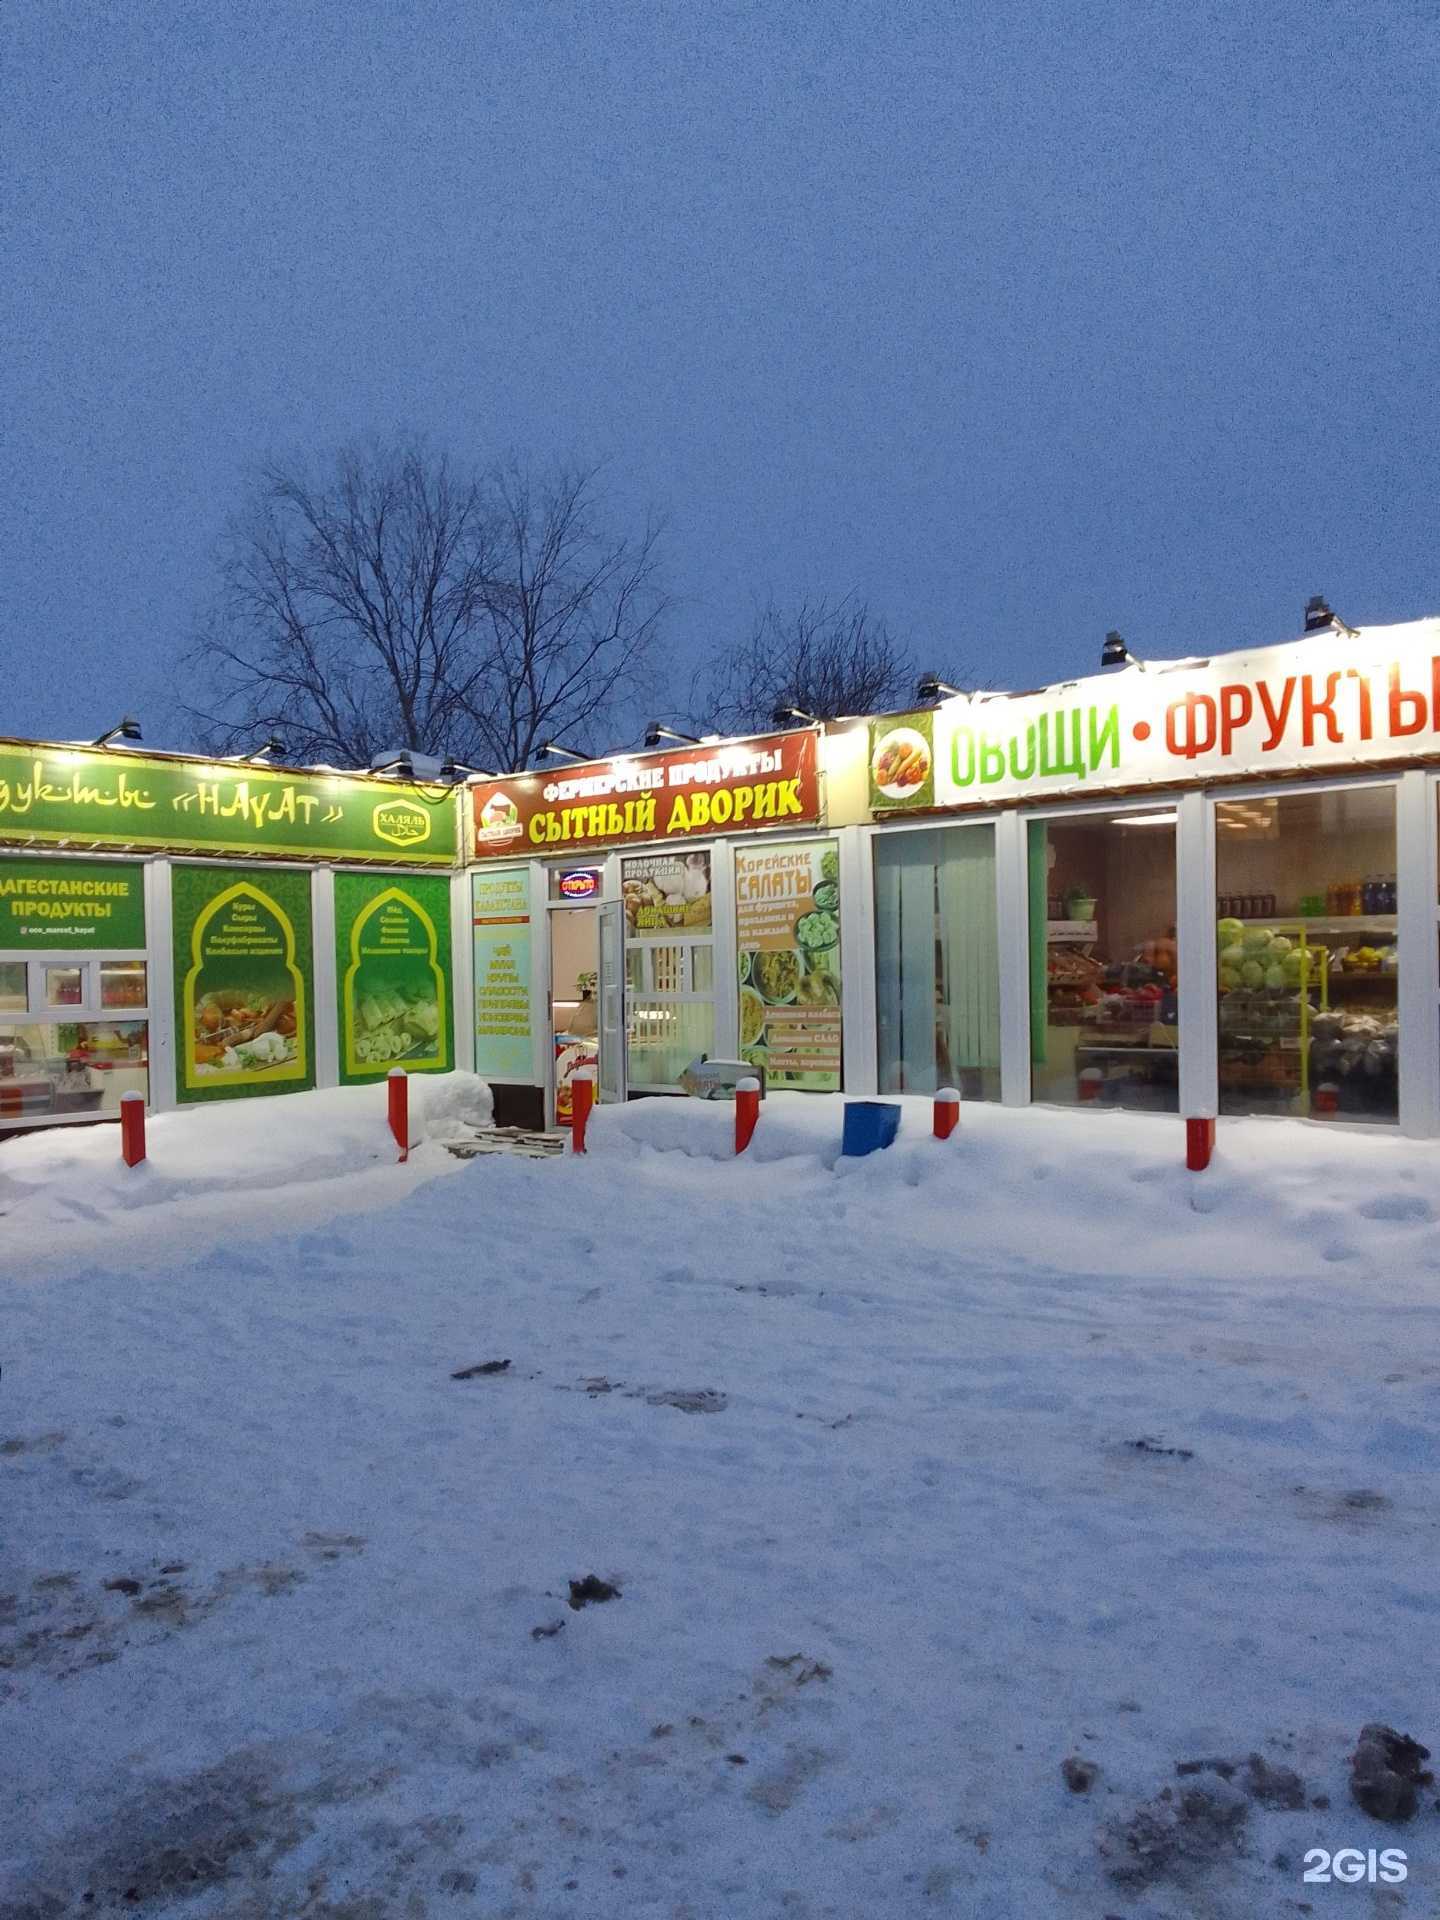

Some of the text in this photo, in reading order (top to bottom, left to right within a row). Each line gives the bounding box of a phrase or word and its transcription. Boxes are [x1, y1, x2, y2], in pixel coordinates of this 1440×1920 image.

[950, 655, 1440, 787] ОВОЩИ ФРУКТЫ
[543, 749, 783, 802] ФЕРМЕРСКИЕ ПРОДУКТЫ
[379, 812, 425, 826] ХАЛЯЛЬ
[529, 777, 803, 844] СЫТНЫЙ ДВОРИК
[624, 856, 675, 868] МОЛОЧНАЯ
[561, 879, 595, 891] ОТКРЫТО
[738, 868, 812, 899] САЛАТЫ
[11, 901, 112, 918] ПРОДУКТЫ
